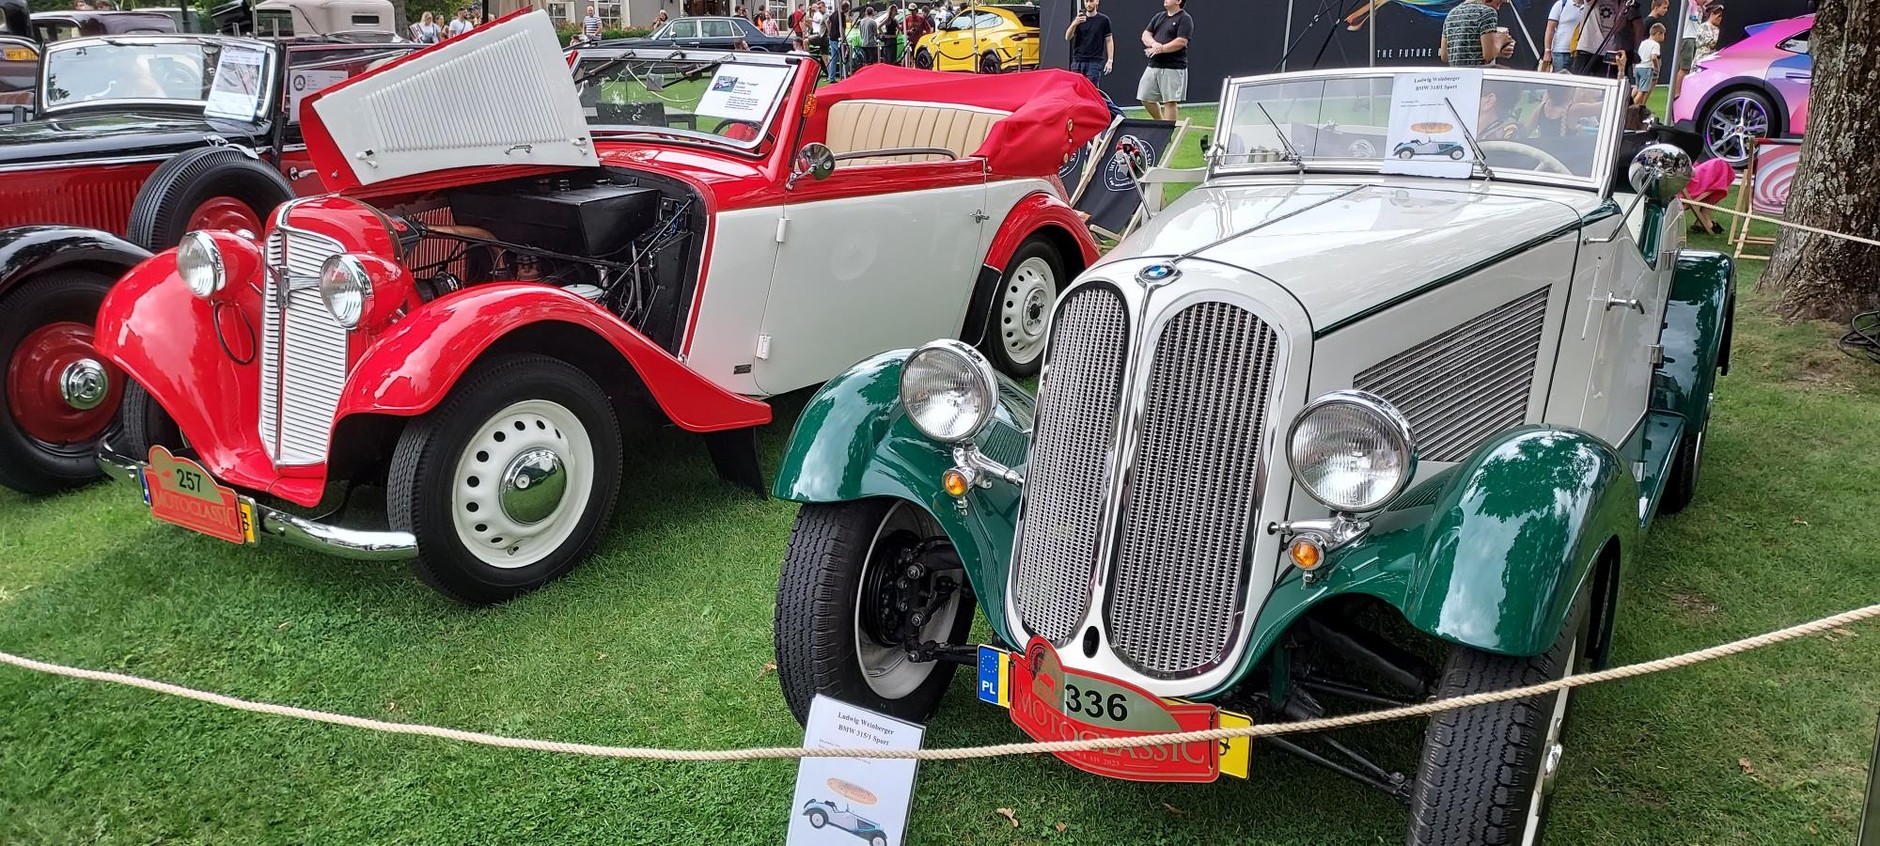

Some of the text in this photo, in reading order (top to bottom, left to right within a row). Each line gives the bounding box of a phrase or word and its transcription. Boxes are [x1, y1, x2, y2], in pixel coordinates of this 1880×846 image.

[1377, 49, 1393, 58] THE
[1399, 48, 1432, 58] FUTURE
[176, 469, 201, 492] 257
[982, 681, 996, 695] PL
[1065, 684, 1128, 722] 336
[838, 712, 894, 735] Ludwig Weinberger
[838, 724, 889, 746] BMW 315/1 Sport
